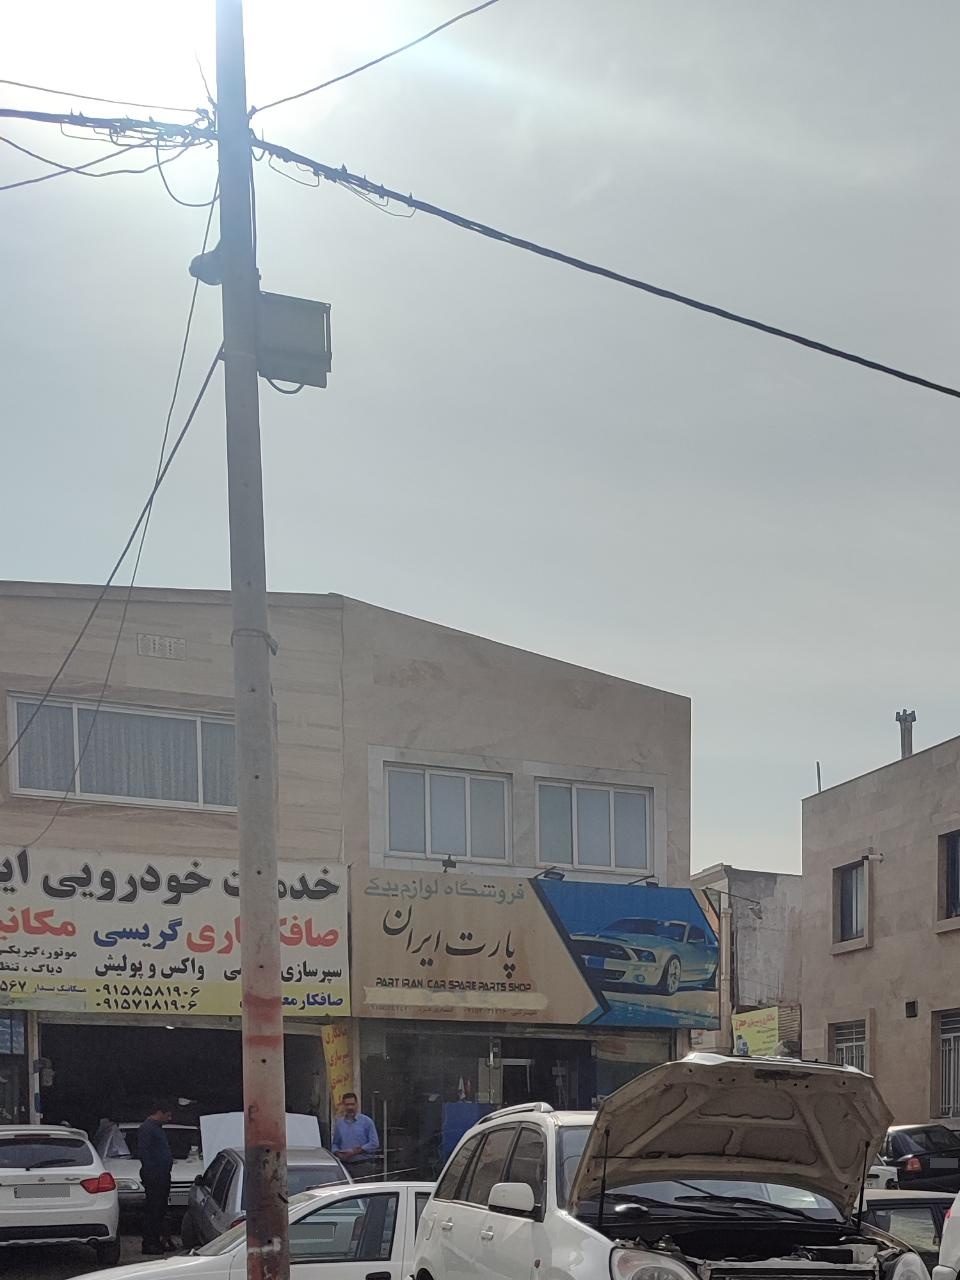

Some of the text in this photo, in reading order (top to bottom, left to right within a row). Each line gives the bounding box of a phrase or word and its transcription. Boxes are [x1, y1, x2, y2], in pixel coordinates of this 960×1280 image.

[43, 861, 212, 904] خودرویی
[223, 867, 340, 900] خدمت
[400, 878, 438, 900] لوازم
[443, 880, 525, 905] فروشگاه
[93, 917, 183, 949] گریسی
[383, 904, 515, 979] پارت ایران
[95, 954, 143, 979] پولیش
[149, 965, 157, 978] و
[161, 957, 205, 980] واکس
[96, 983, 200, 998] ۰۹۱۵۸۵۸۱۹۰۶
[376, 977, 400, 988] PART
[427, 980, 447, 990] CAR
[448, 980, 477, 990] SPARE
[479, 982, 507, 992] PARTS
[508, 983, 532, 992] SHOP
[96, 998, 198, 1011] ۰۹۱۵۷۱۸۱۹۰۶
[299, 992, 344, 1010] صافکار
